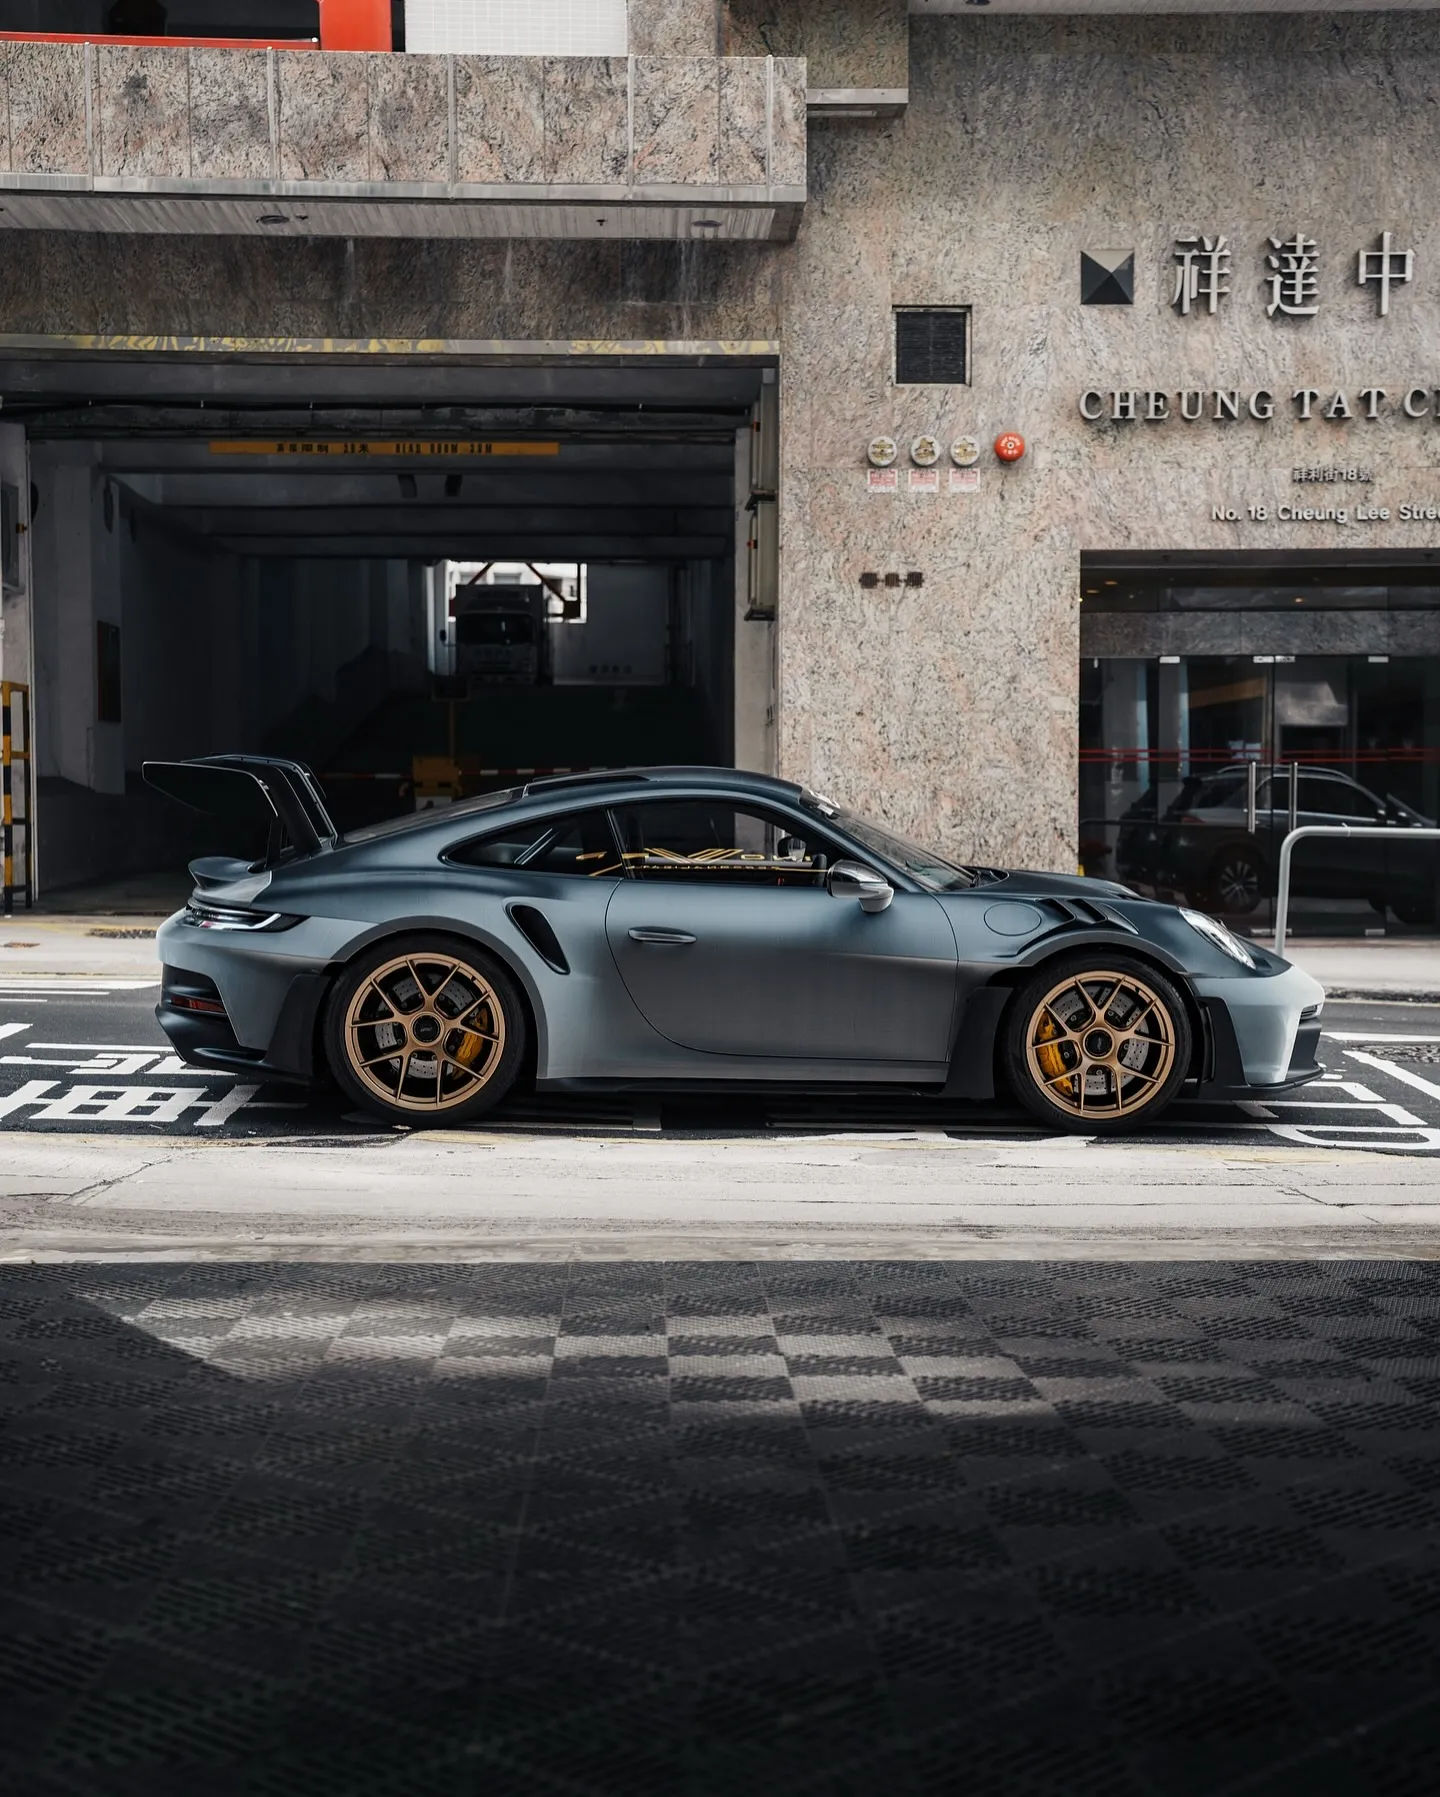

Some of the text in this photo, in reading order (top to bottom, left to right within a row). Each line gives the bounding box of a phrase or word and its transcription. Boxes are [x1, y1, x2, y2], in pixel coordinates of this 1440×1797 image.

[1172, 231, 1416, 316] 祥達中
[1079, 387, 1440, 420] CHEUNG TAT C
[1211, 505, 1242, 521] No.
[1248, 506, 1268, 520] 18
[1277, 504, 1348, 523] Cheung
[1356, 505, 1391, 521] Lee
